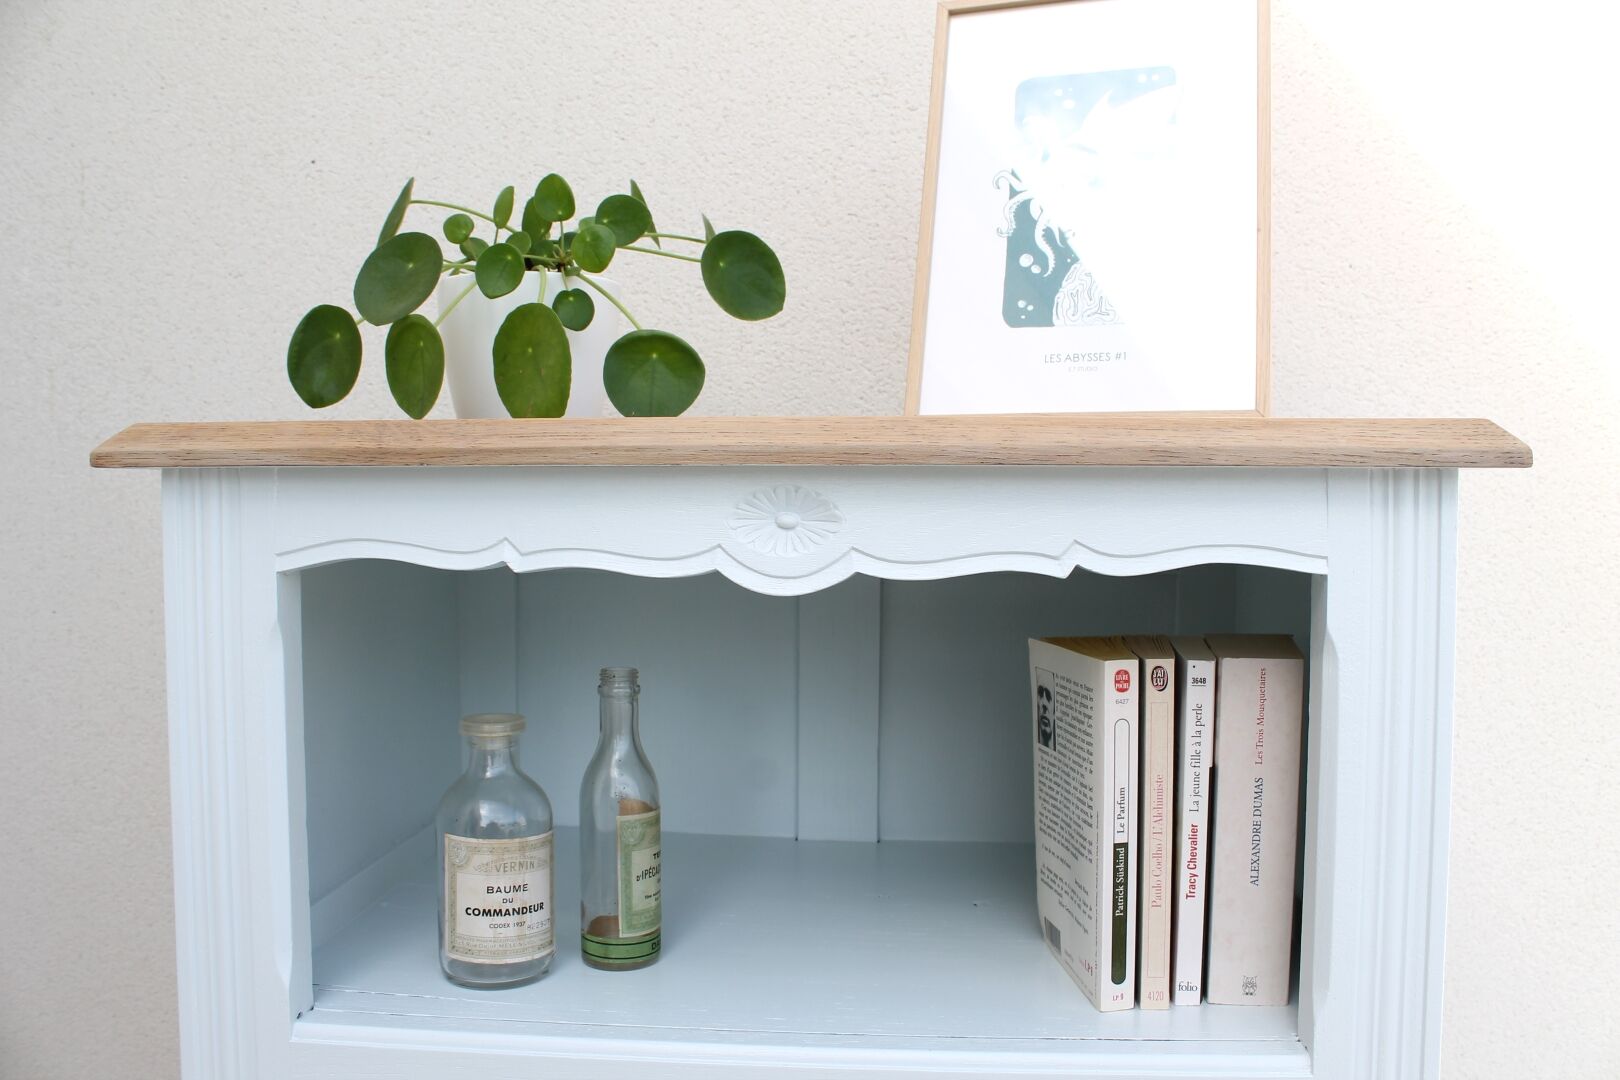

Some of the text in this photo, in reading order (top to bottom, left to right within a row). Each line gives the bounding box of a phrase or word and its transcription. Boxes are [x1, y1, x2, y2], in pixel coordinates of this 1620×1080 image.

[1044, 354, 1062, 364] LES
[1064, 352, 1110, 362] ABYSSES
[1192, 704, 1205, 727] perle
[1254, 667, 1270, 764] Les Trois Mousquetaires
[1192, 730, 1202, 738] la
[1190, 750, 1201, 768] fille
[1190, 772, 1202, 798] jeune
[1116, 787, 1126, 834] Le Parfum
[1188, 800, 1200, 812] La
[1249, 777, 1264, 887] ALEXANDRE DUMAS
[496, 861, 534, 873] VERNIN
[1152, 843, 1163, 878] Coelho
[1186, 824, 1199, 900] Tracy Chevalier
[486, 884, 528, 894] BAUME
[1116, 848, 1125, 916] Patrick Süskind
[1151, 880, 1162, 908] Paulo
[465, 902, 544, 917] COMMANDEUR
[1148, 991, 1164, 1000] 4120
[1178, 980, 1198, 992] folio
